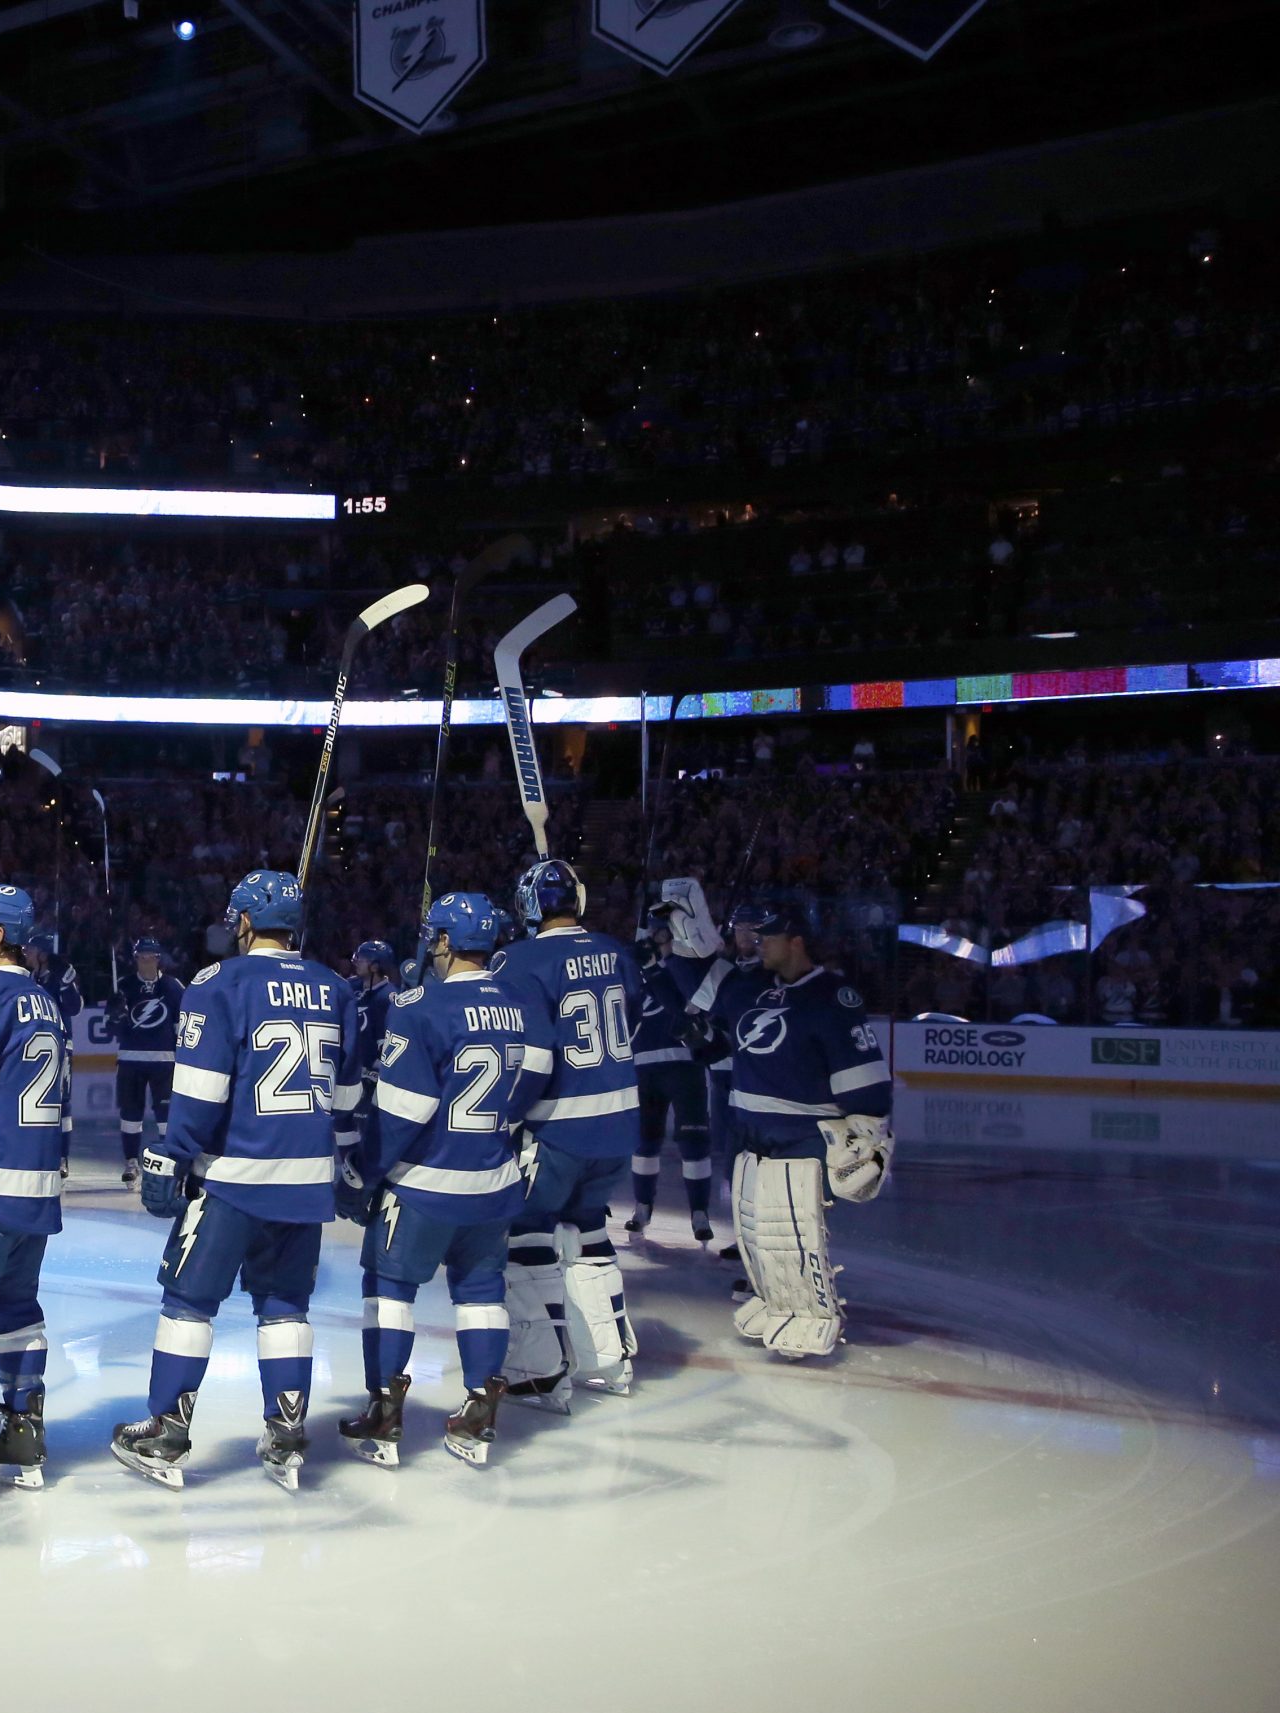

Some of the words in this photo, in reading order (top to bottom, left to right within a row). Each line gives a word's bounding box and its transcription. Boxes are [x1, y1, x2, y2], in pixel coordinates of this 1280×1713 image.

[343, 497, 387, 514] 1:55
[504, 686, 542, 804] WARRIOR
[282, 886, 294, 897] 25
[481, 919, 493, 930] 27
[566, 952, 618, 980] BISHOP
[267, 981, 332, 1011] CARLE
[560, 984, 634, 1069] 30
[851, 1022, 878, 1052] 35
[925, 1028, 979, 1047] ROSE
[924, 1049, 1026, 1067] RADIOLOGY
[1095, 1038, 1156, 1063] USF
[1165, 1038, 1270, 1053] UNIVERSITY
[252, 1018, 341, 1116] 25
[1165, 1055, 1220, 1070] SOUTH
[808, 1252, 829, 1309] CCM
